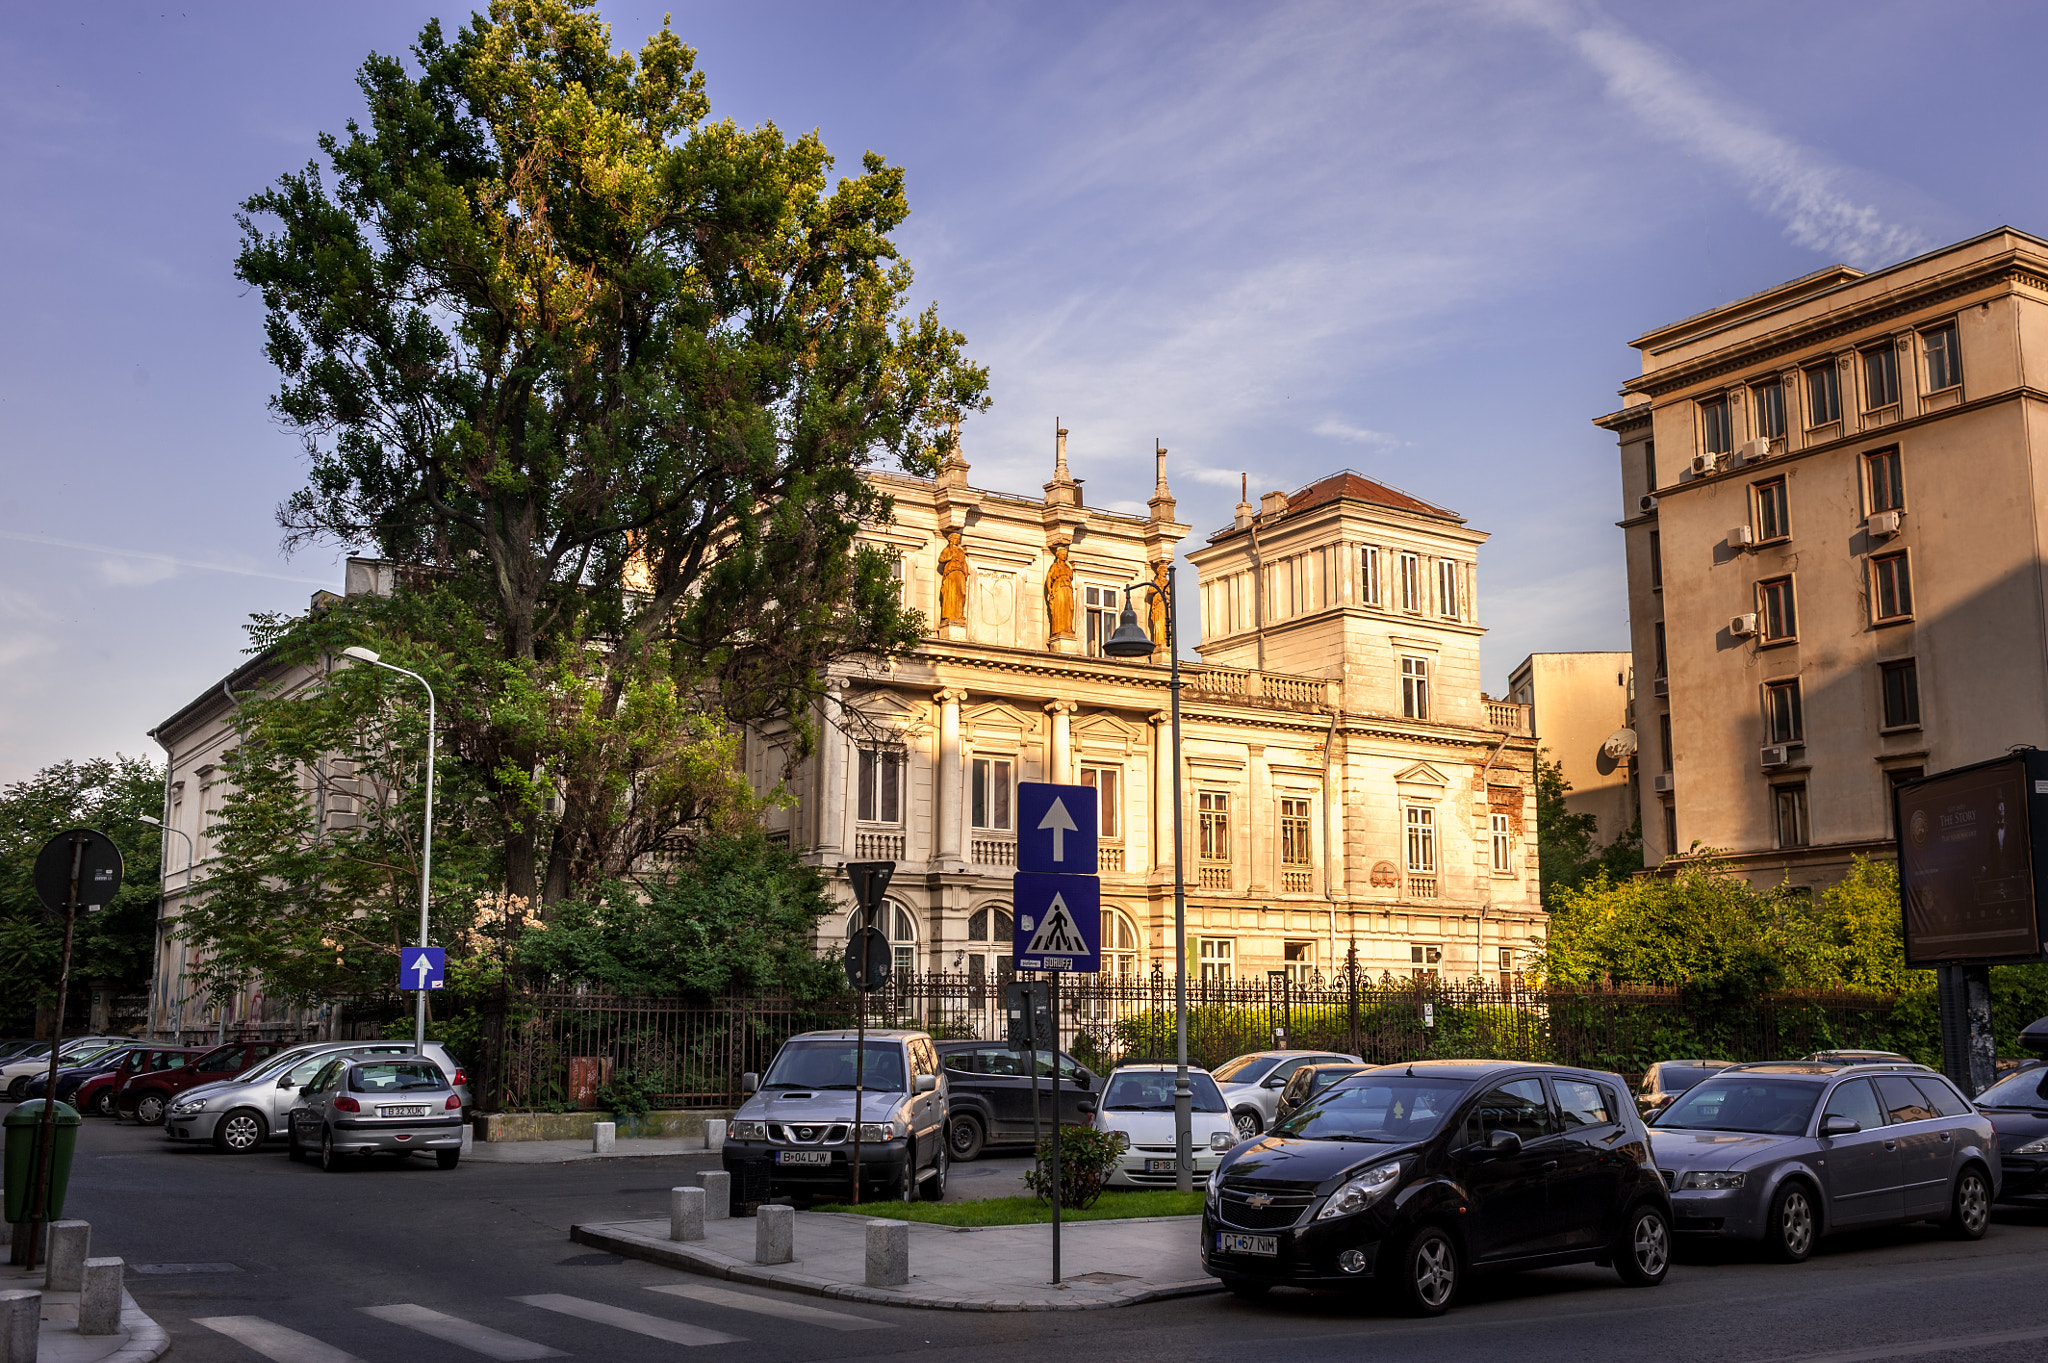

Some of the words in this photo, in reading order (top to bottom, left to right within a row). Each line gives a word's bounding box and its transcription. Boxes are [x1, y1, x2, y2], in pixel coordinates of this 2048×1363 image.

[1939, 814, 1953, 827] THE
[1954, 809, 1976, 824] STORY
[795, 1152, 806, 1162] 04
[808, 1153, 827, 1162] LJW
[1242, 1236, 1254, 1250] 67
